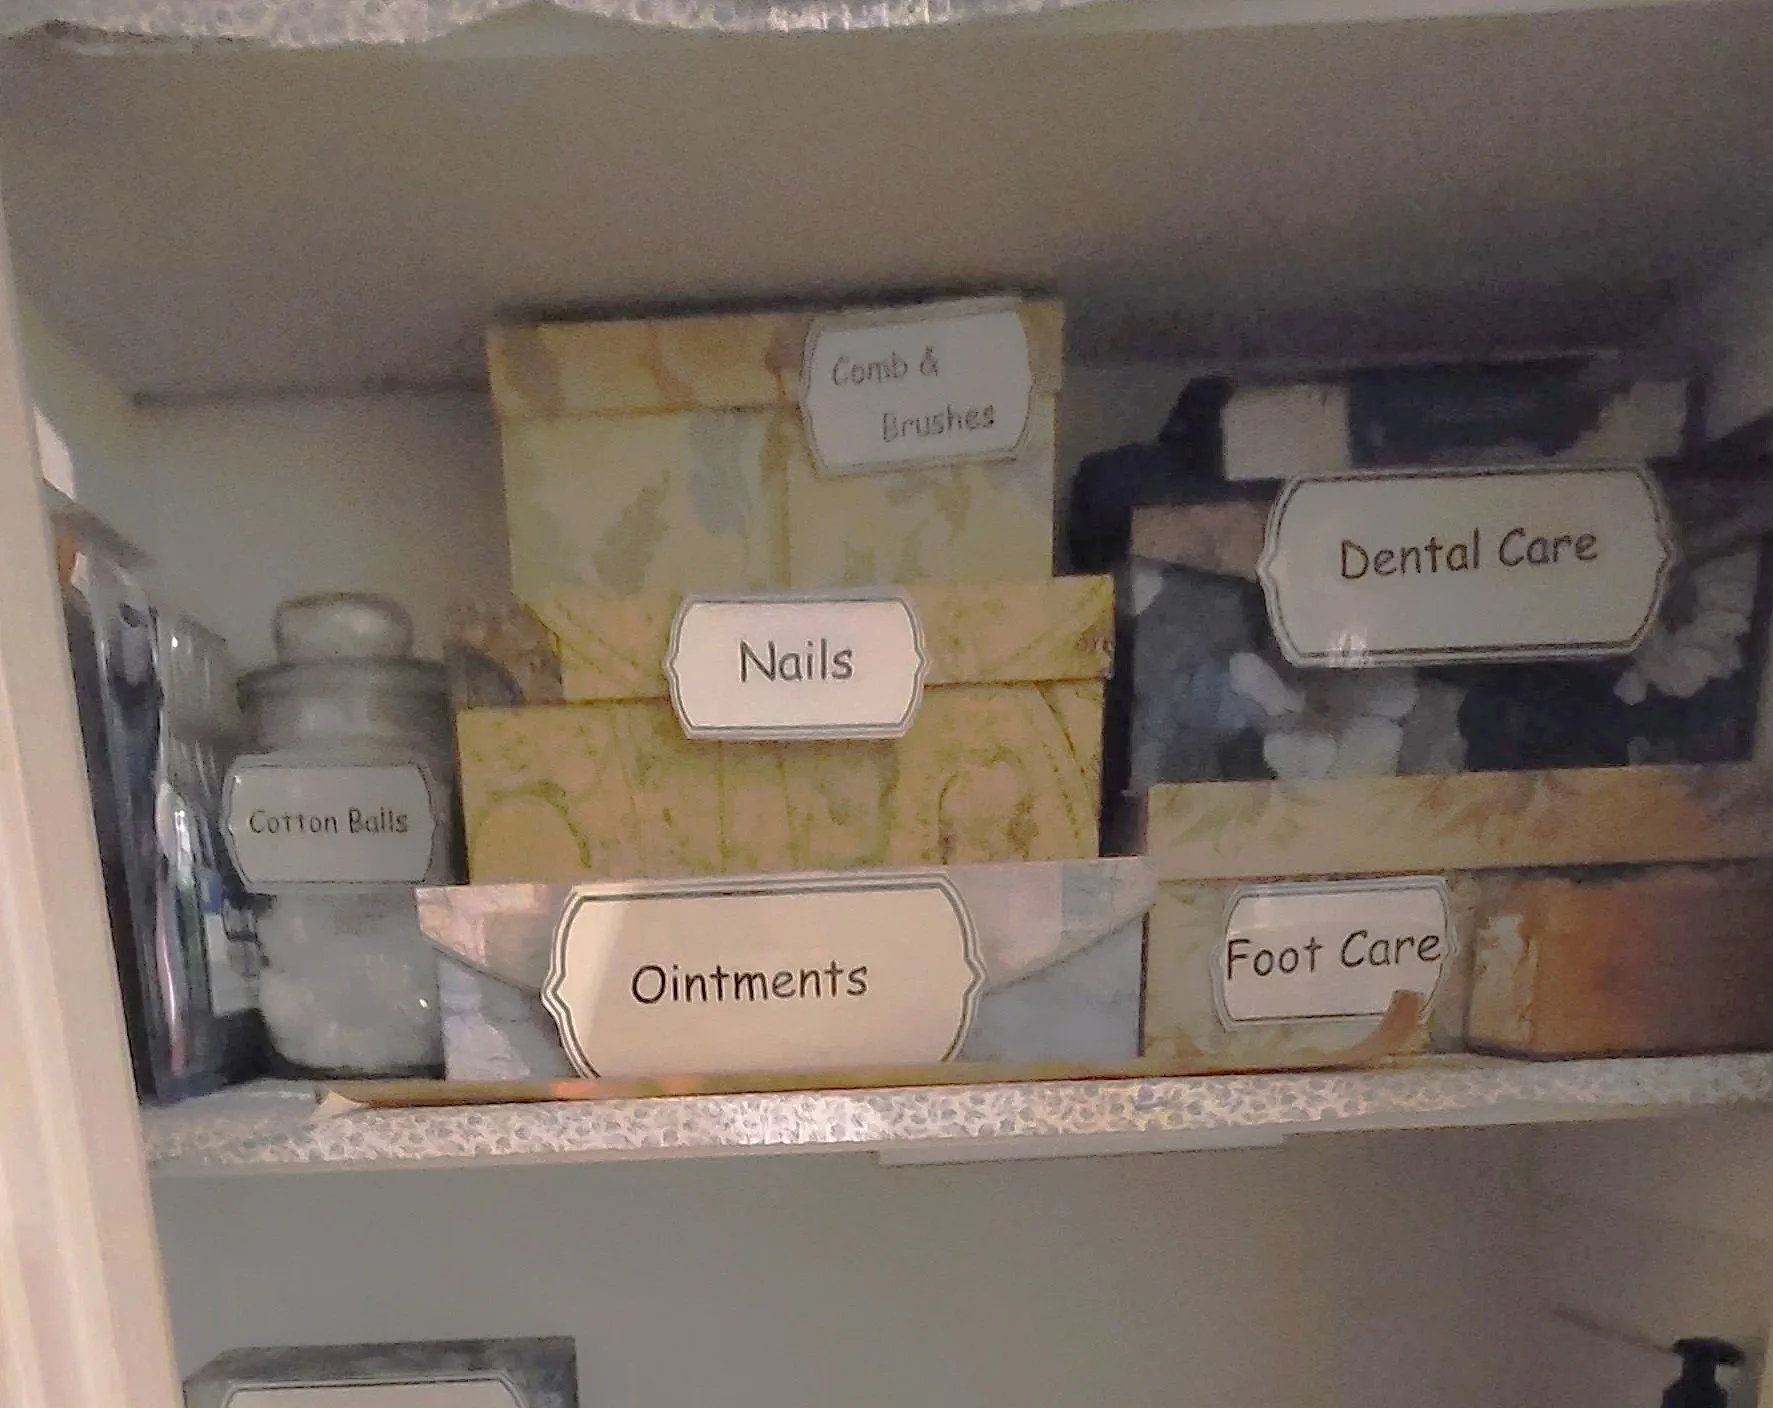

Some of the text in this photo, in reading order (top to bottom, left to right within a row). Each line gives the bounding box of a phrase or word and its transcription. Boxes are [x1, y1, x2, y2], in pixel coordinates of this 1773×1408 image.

[831, 345, 940, 387] Comb &
[882, 403, 996, 443] Brushes
[1341, 526, 1599, 581] Dental Care
[739, 637, 853, 683] Nails
[248, 807, 409, 835] Cotton Balls
[1225, 929, 1442, 981] Foot Care
[630, 959, 869, 1006] Ointments
